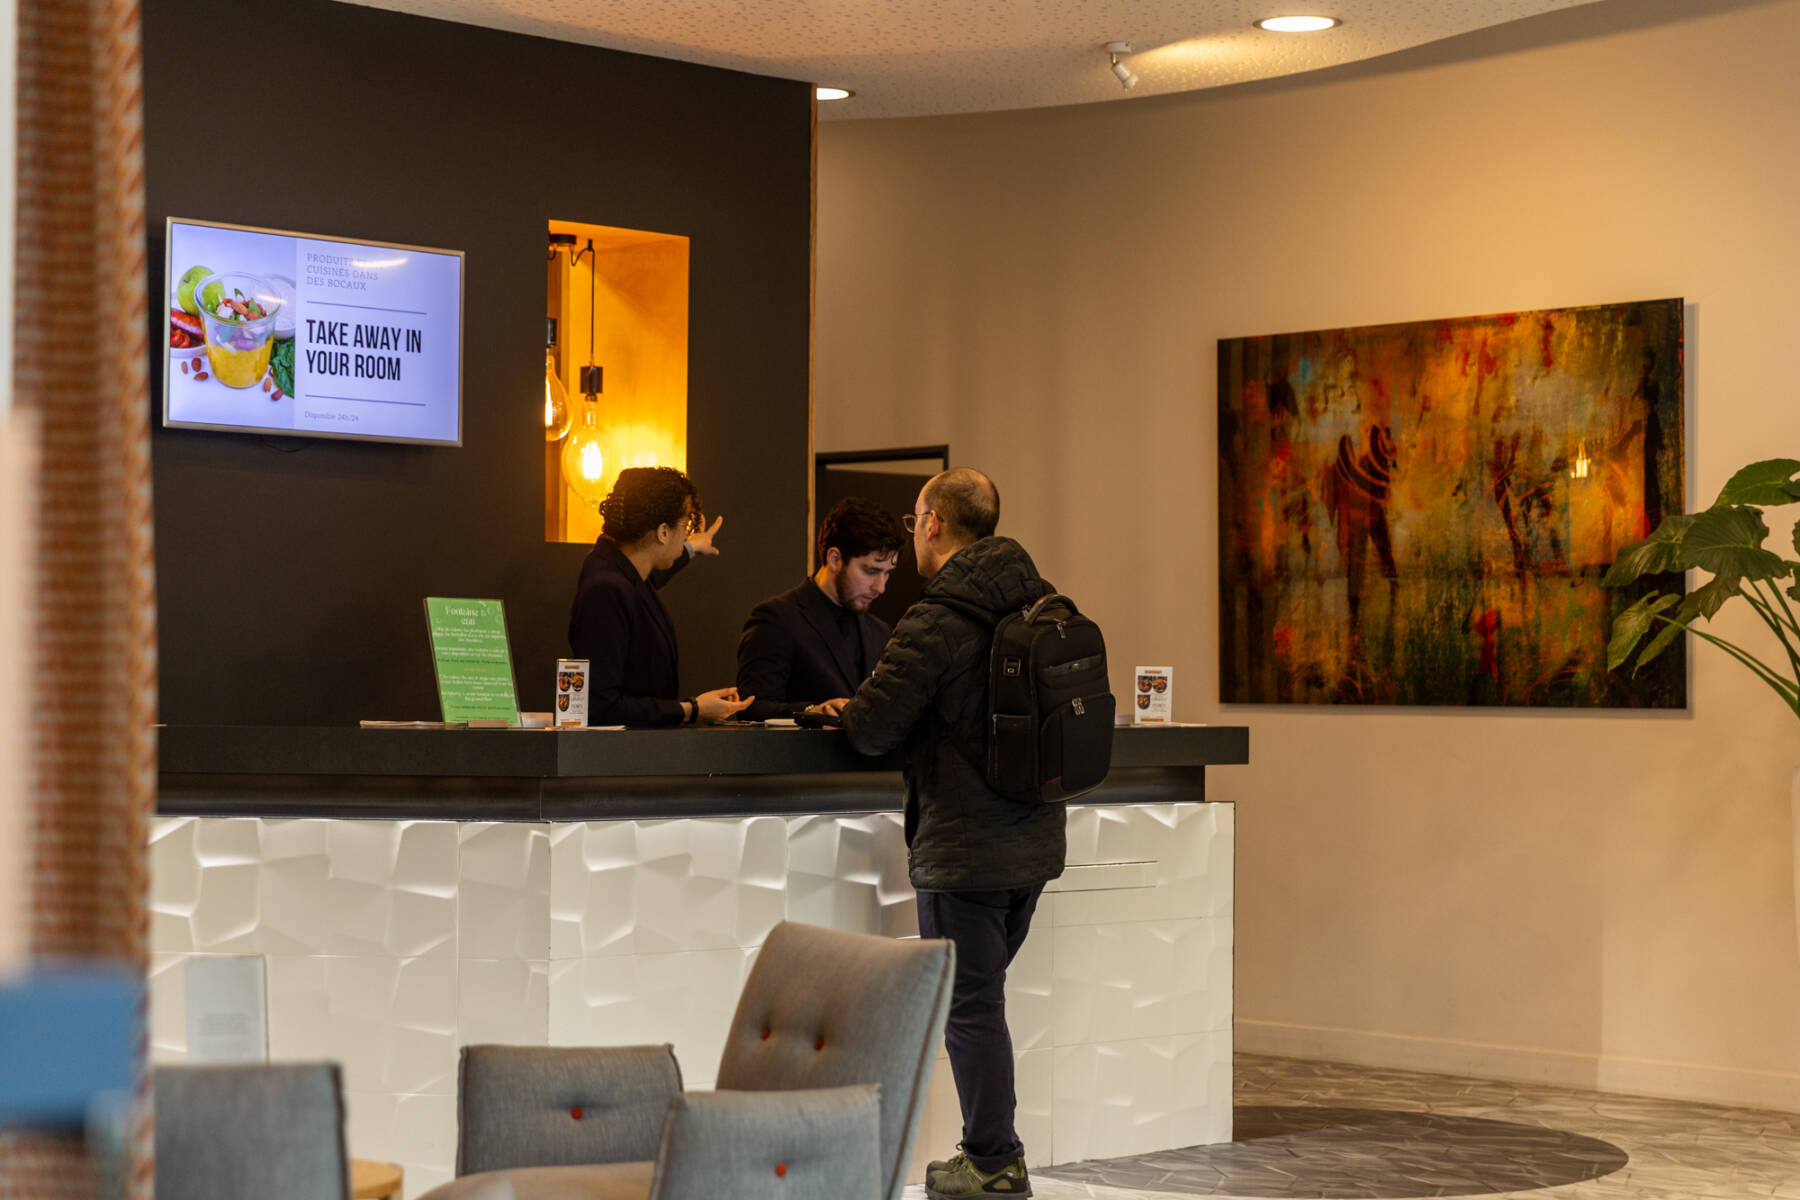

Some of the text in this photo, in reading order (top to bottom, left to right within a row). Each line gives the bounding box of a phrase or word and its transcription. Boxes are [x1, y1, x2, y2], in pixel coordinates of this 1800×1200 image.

[306, 265, 379, 280] CUISINES DANS
[306, 276, 367, 291] DES BOCAUX
[306, 319, 422, 353] TAKE AWAY IN
[305, 349, 401, 381] YOUR ROOM
